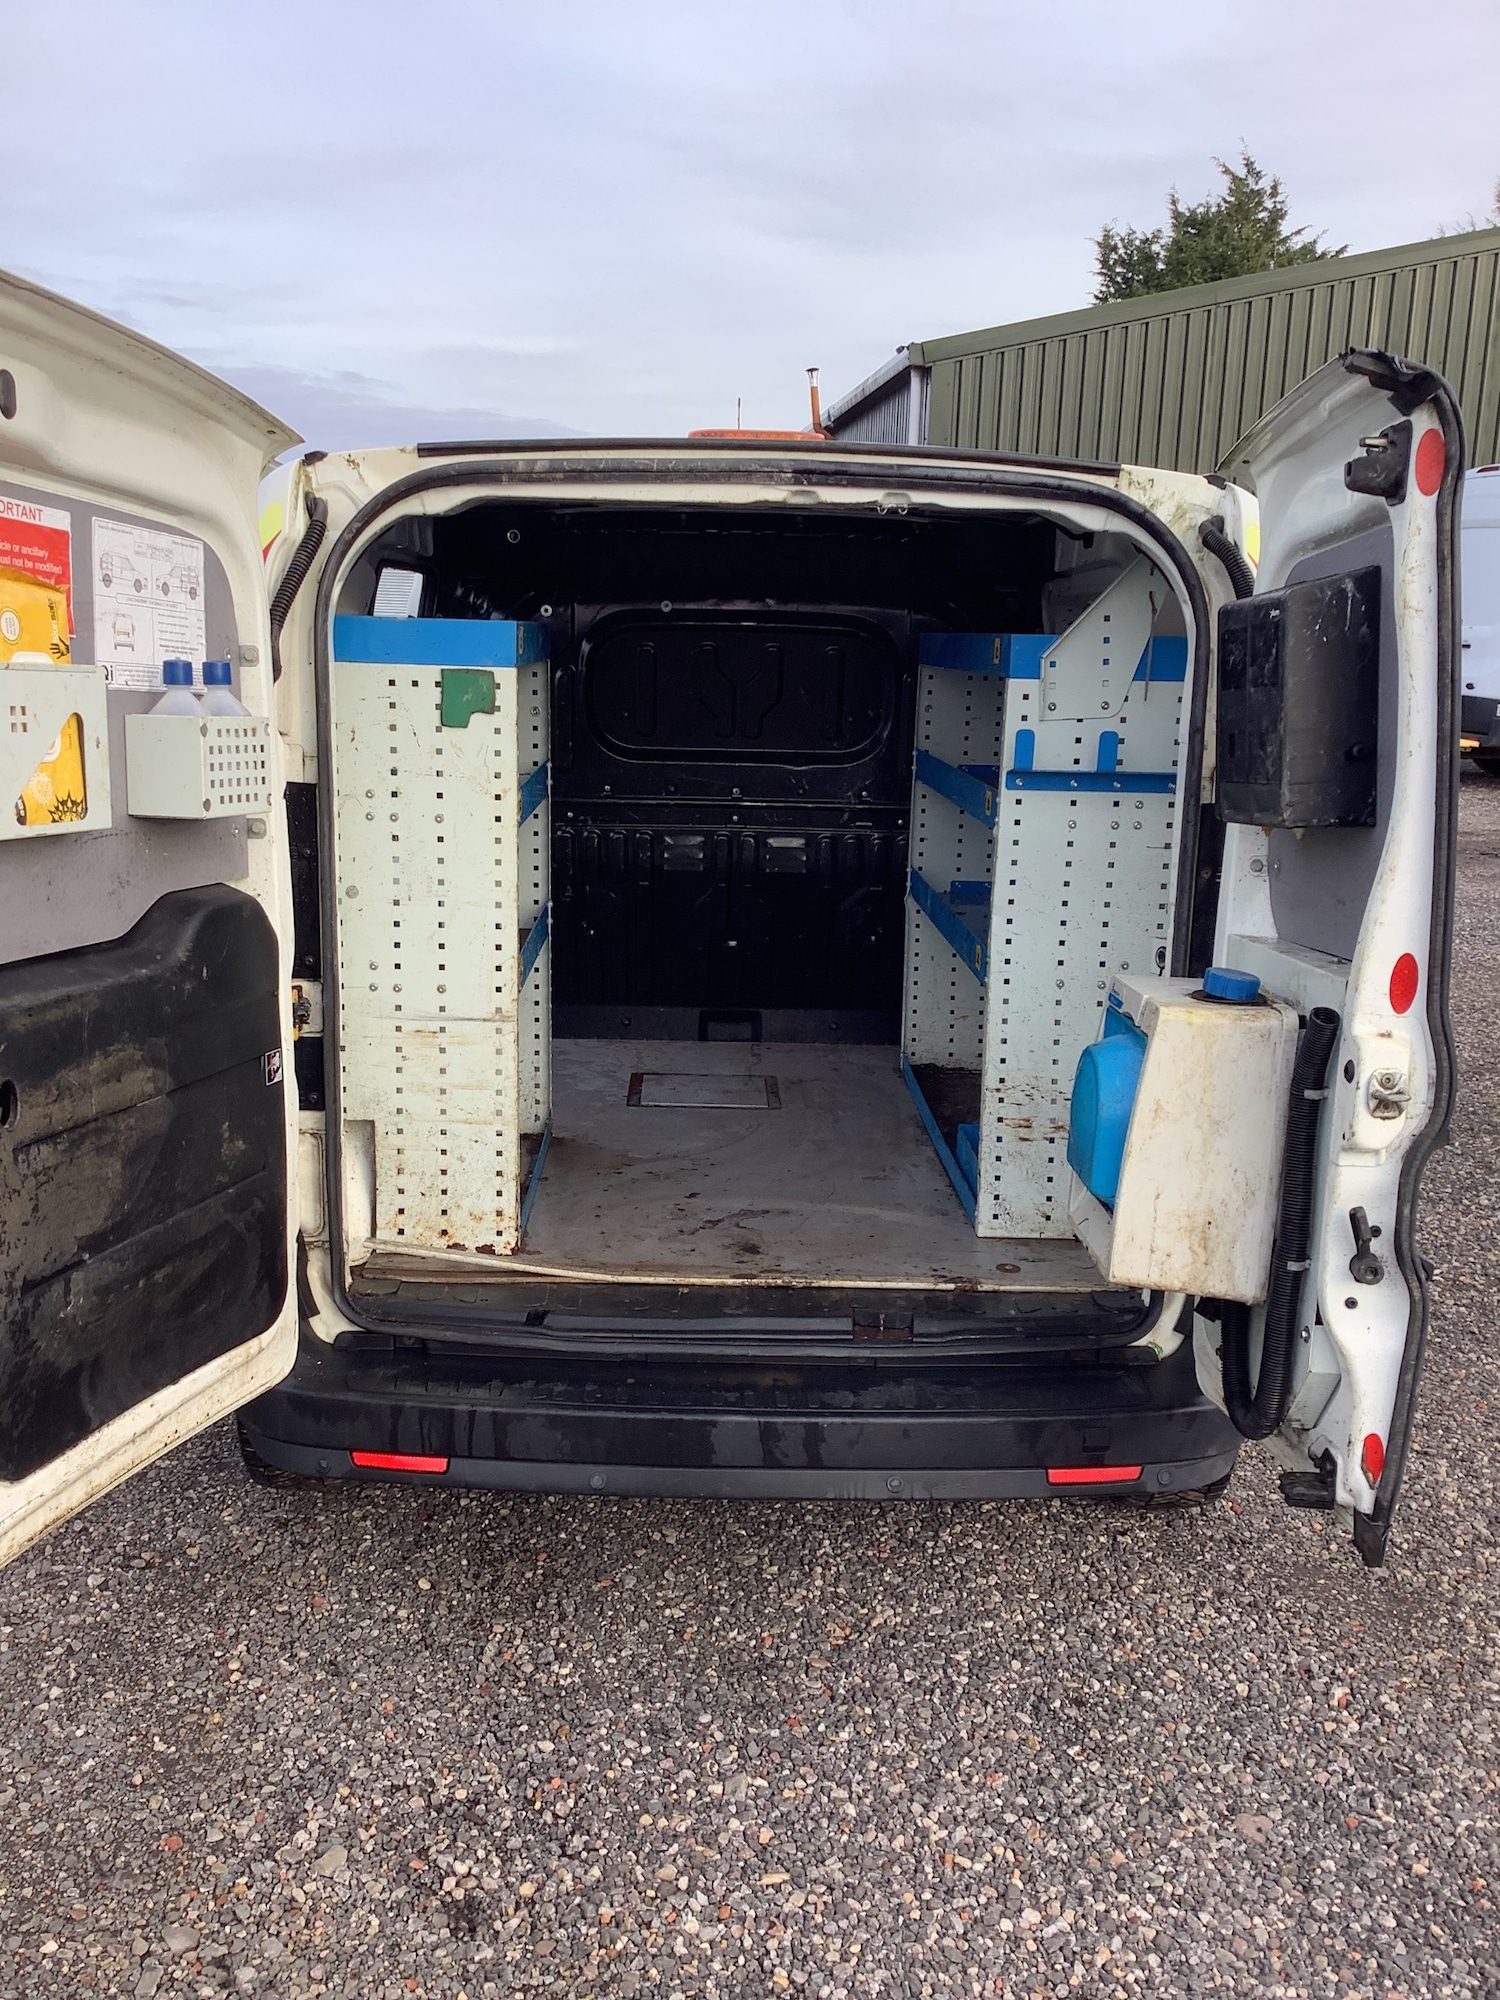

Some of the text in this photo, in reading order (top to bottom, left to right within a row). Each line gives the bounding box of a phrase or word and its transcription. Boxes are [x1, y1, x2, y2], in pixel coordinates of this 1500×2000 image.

[12, 543, 20, 553] or
[21, 545, 49, 560] ancillary
[12, 557, 24, 568] not
[24, 558, 33, 569] be
[35, 562, 62, 574] modified
